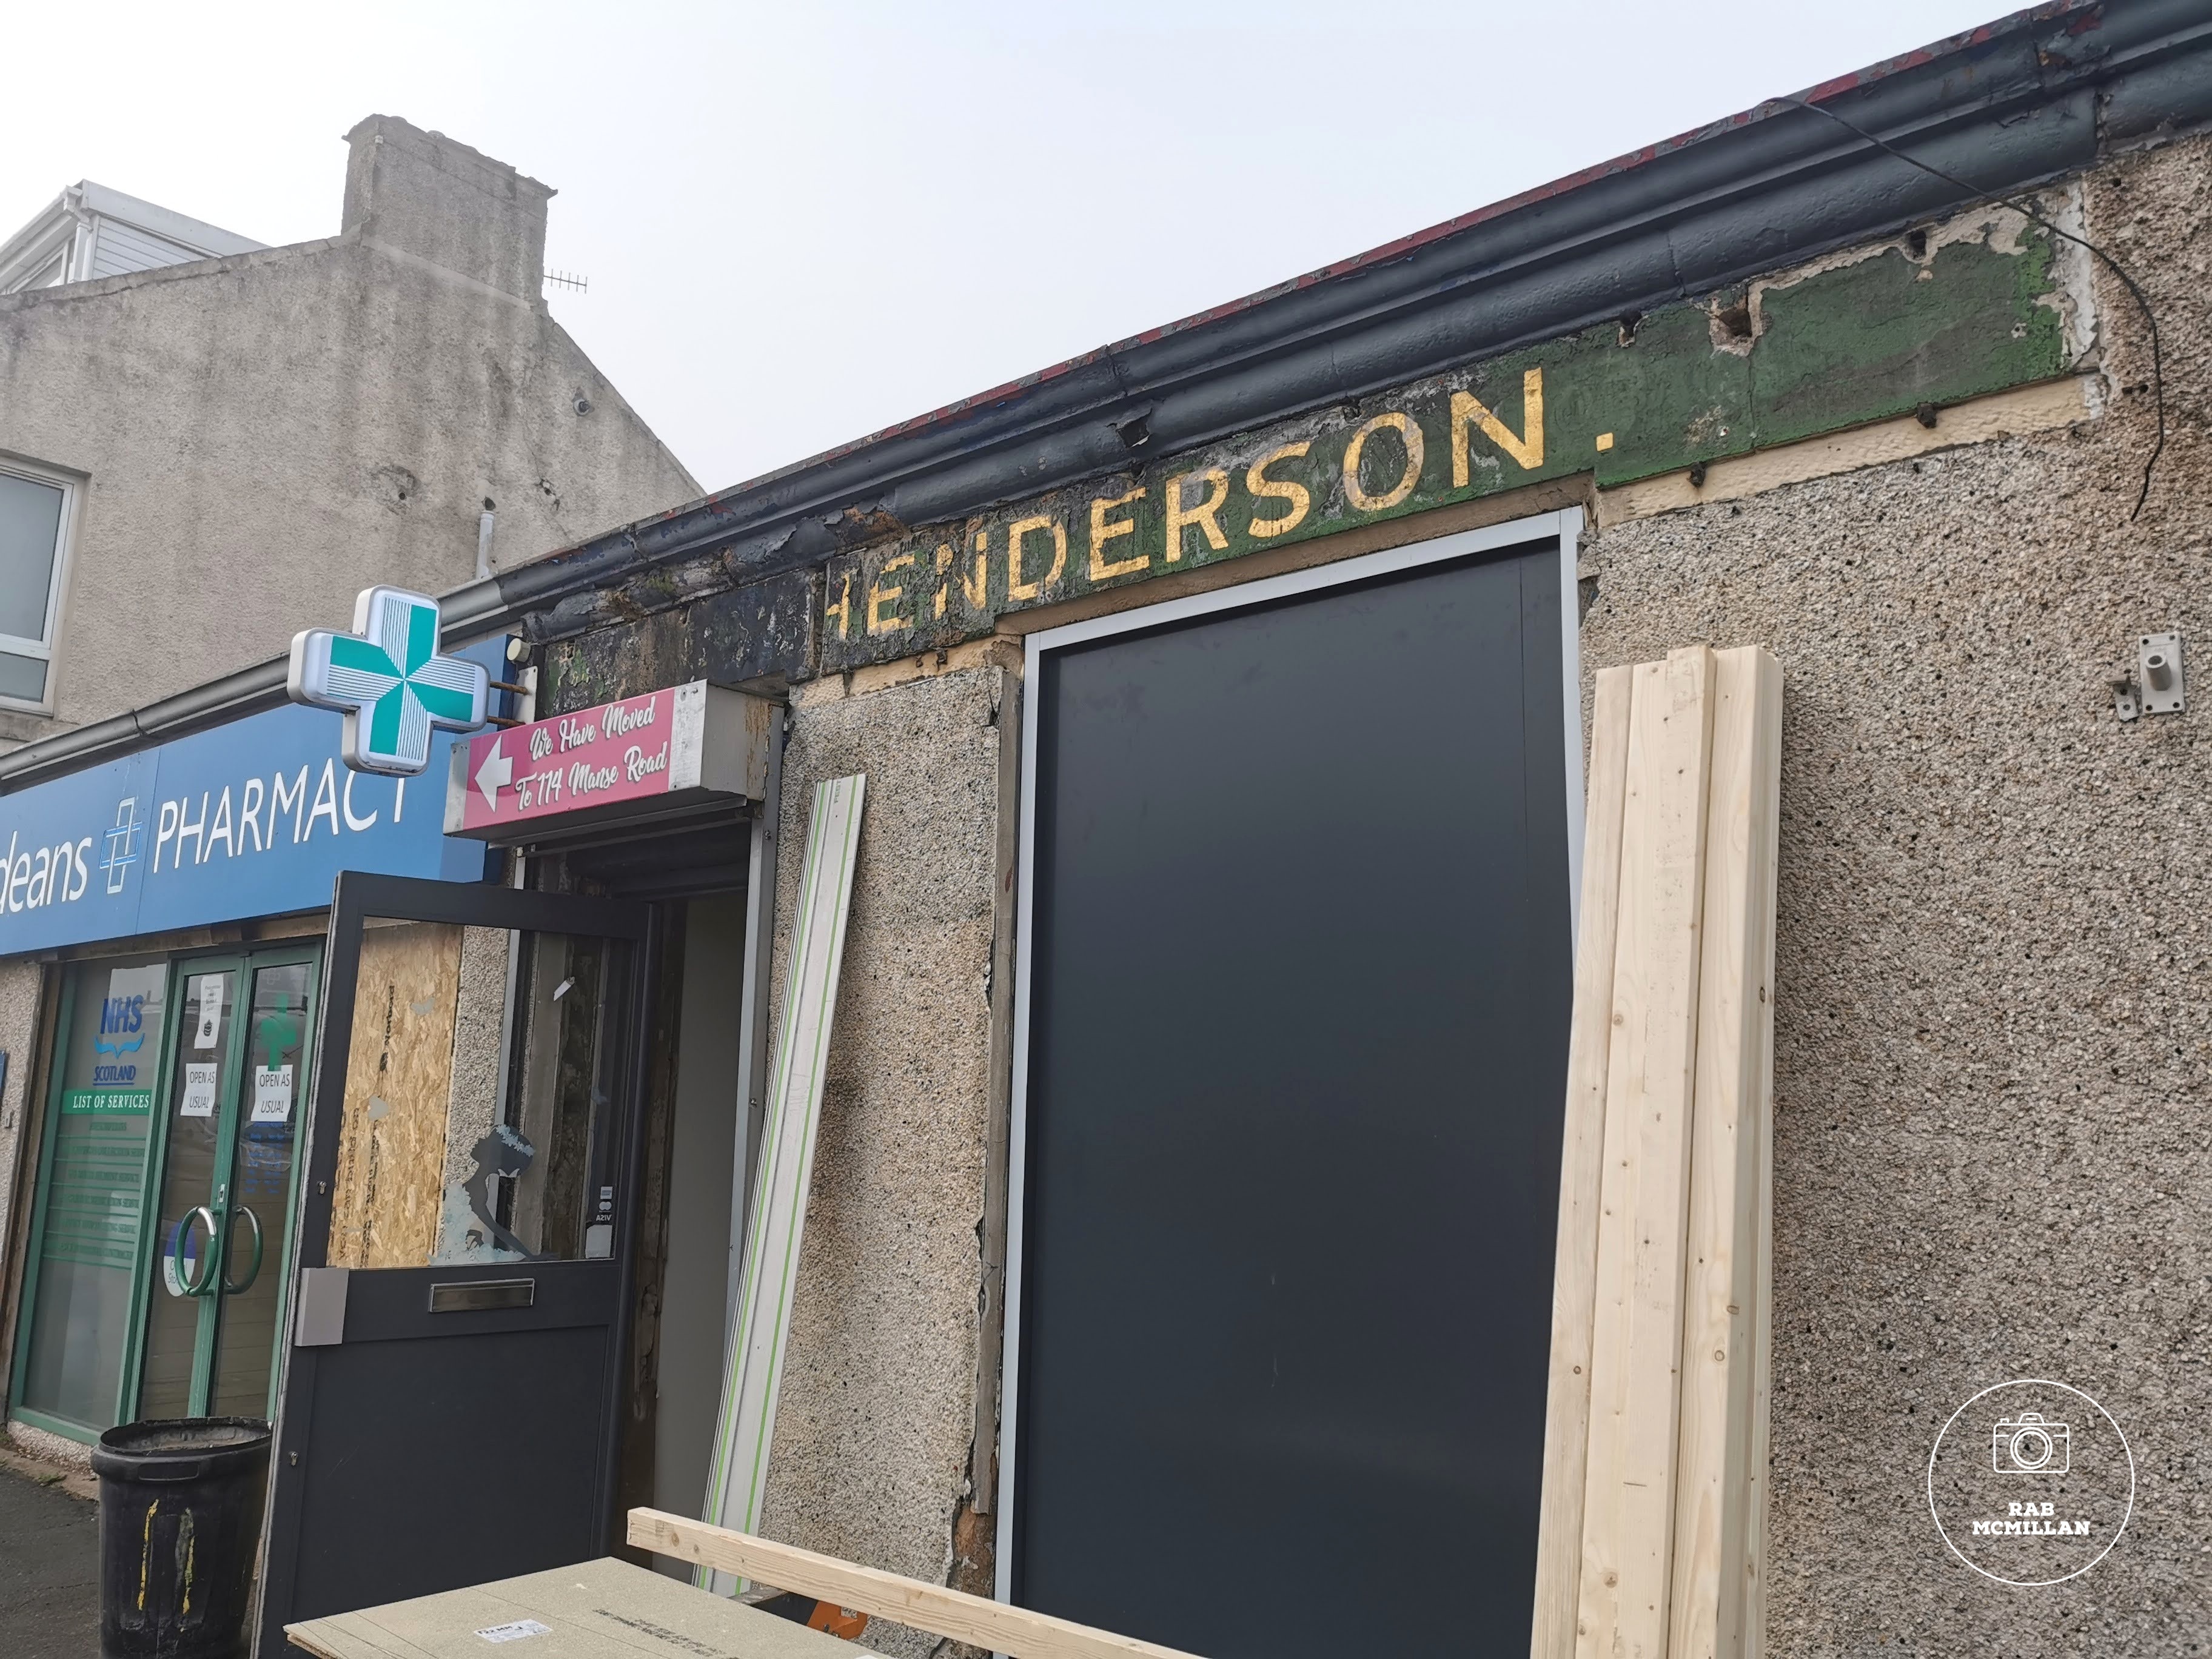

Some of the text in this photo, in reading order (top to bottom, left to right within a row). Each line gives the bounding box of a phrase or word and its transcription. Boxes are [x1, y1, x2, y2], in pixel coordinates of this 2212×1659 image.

[529, 696, 655, 760] We Have Moved
[515, 742, 668, 810] To 114 Manse Road
[100, 994, 144, 1034] NHS
[93, 1065, 136, 1082] SCOTLAND
[190, 1071, 215, 1084] OPEN AS
[259, 1074, 290, 1087] OPEN AS
[73, 1094, 149, 1108] LIST OF SERVICES
[189, 1096, 209, 1108] USUAL
[261, 1100, 284, 1113] USUAL
